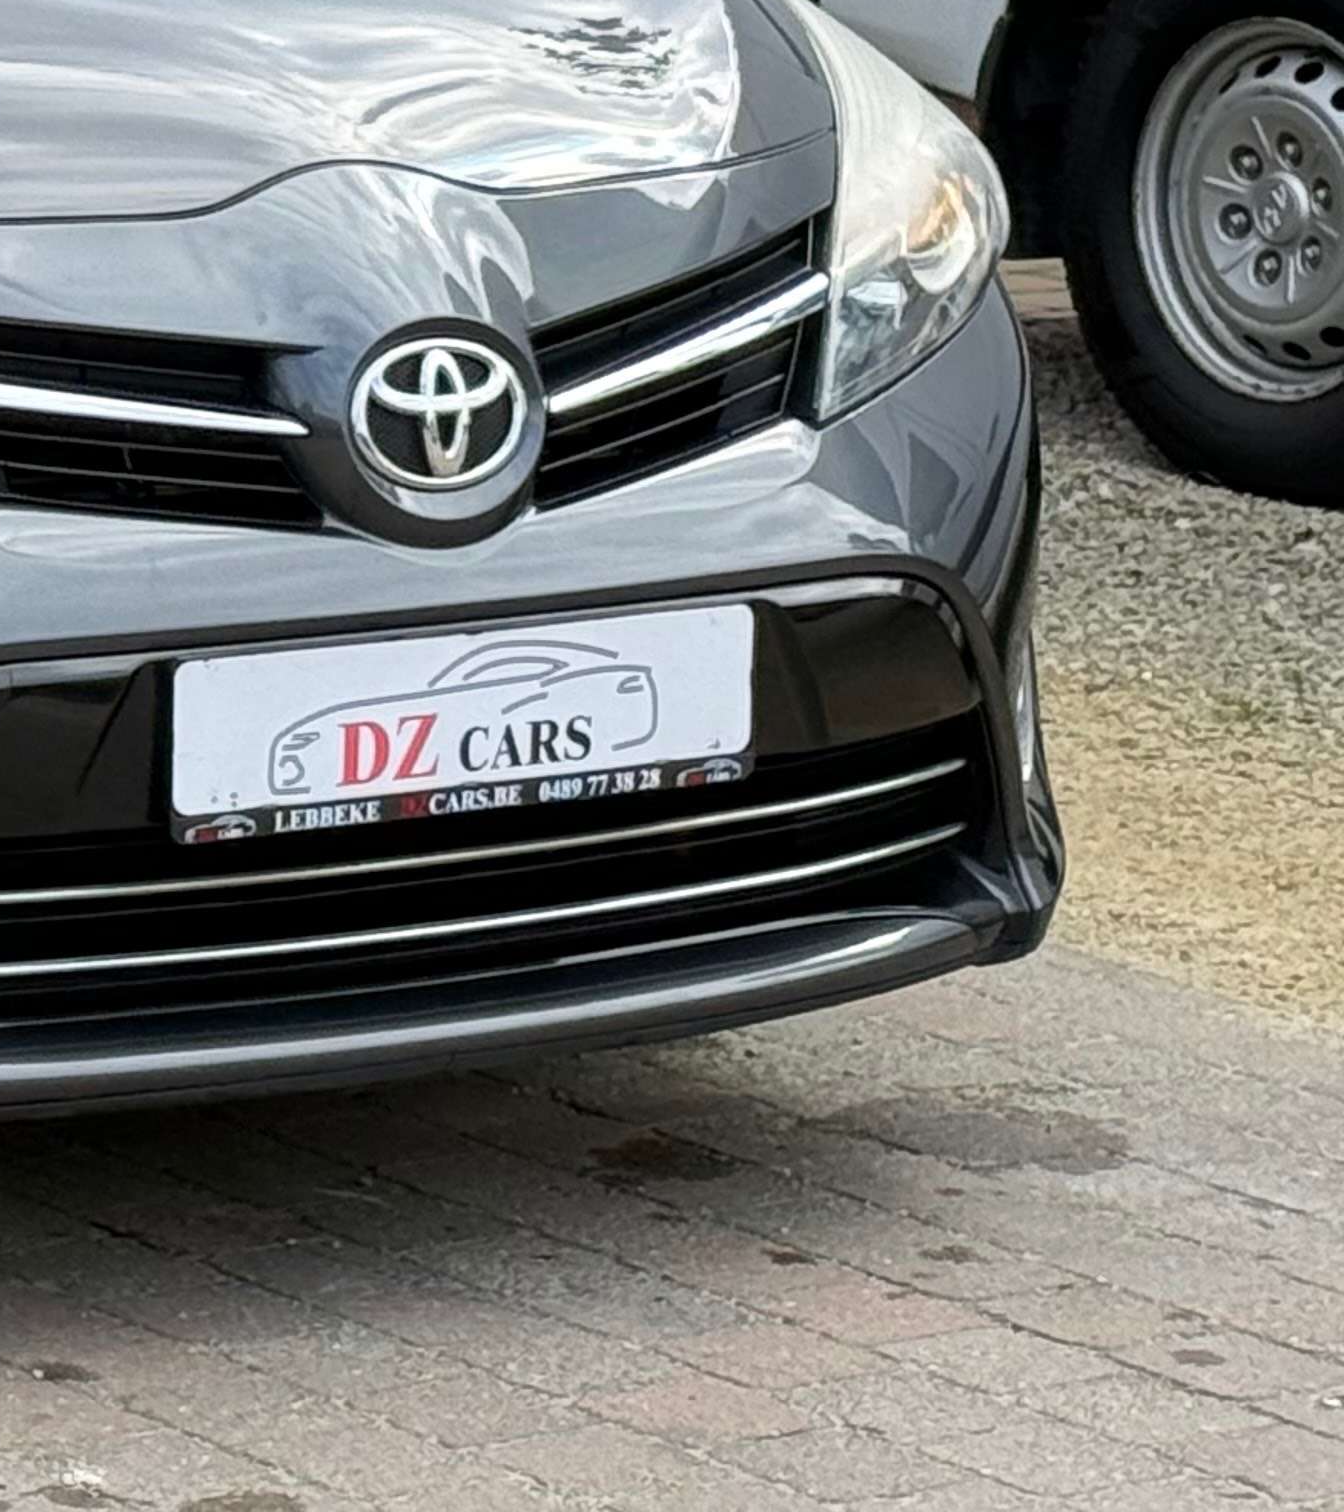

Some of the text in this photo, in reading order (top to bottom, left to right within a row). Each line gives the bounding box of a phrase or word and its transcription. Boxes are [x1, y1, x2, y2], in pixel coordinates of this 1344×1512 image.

[336, 713, 593, 788] DZ CARS
[273, 800, 382, 833] LEBBEKE
[538, 777, 584, 804] 0489
[587, 774, 609, 798] 77
[611, 771, 635, 796] 38
[638, 767, 662, 791] 28
